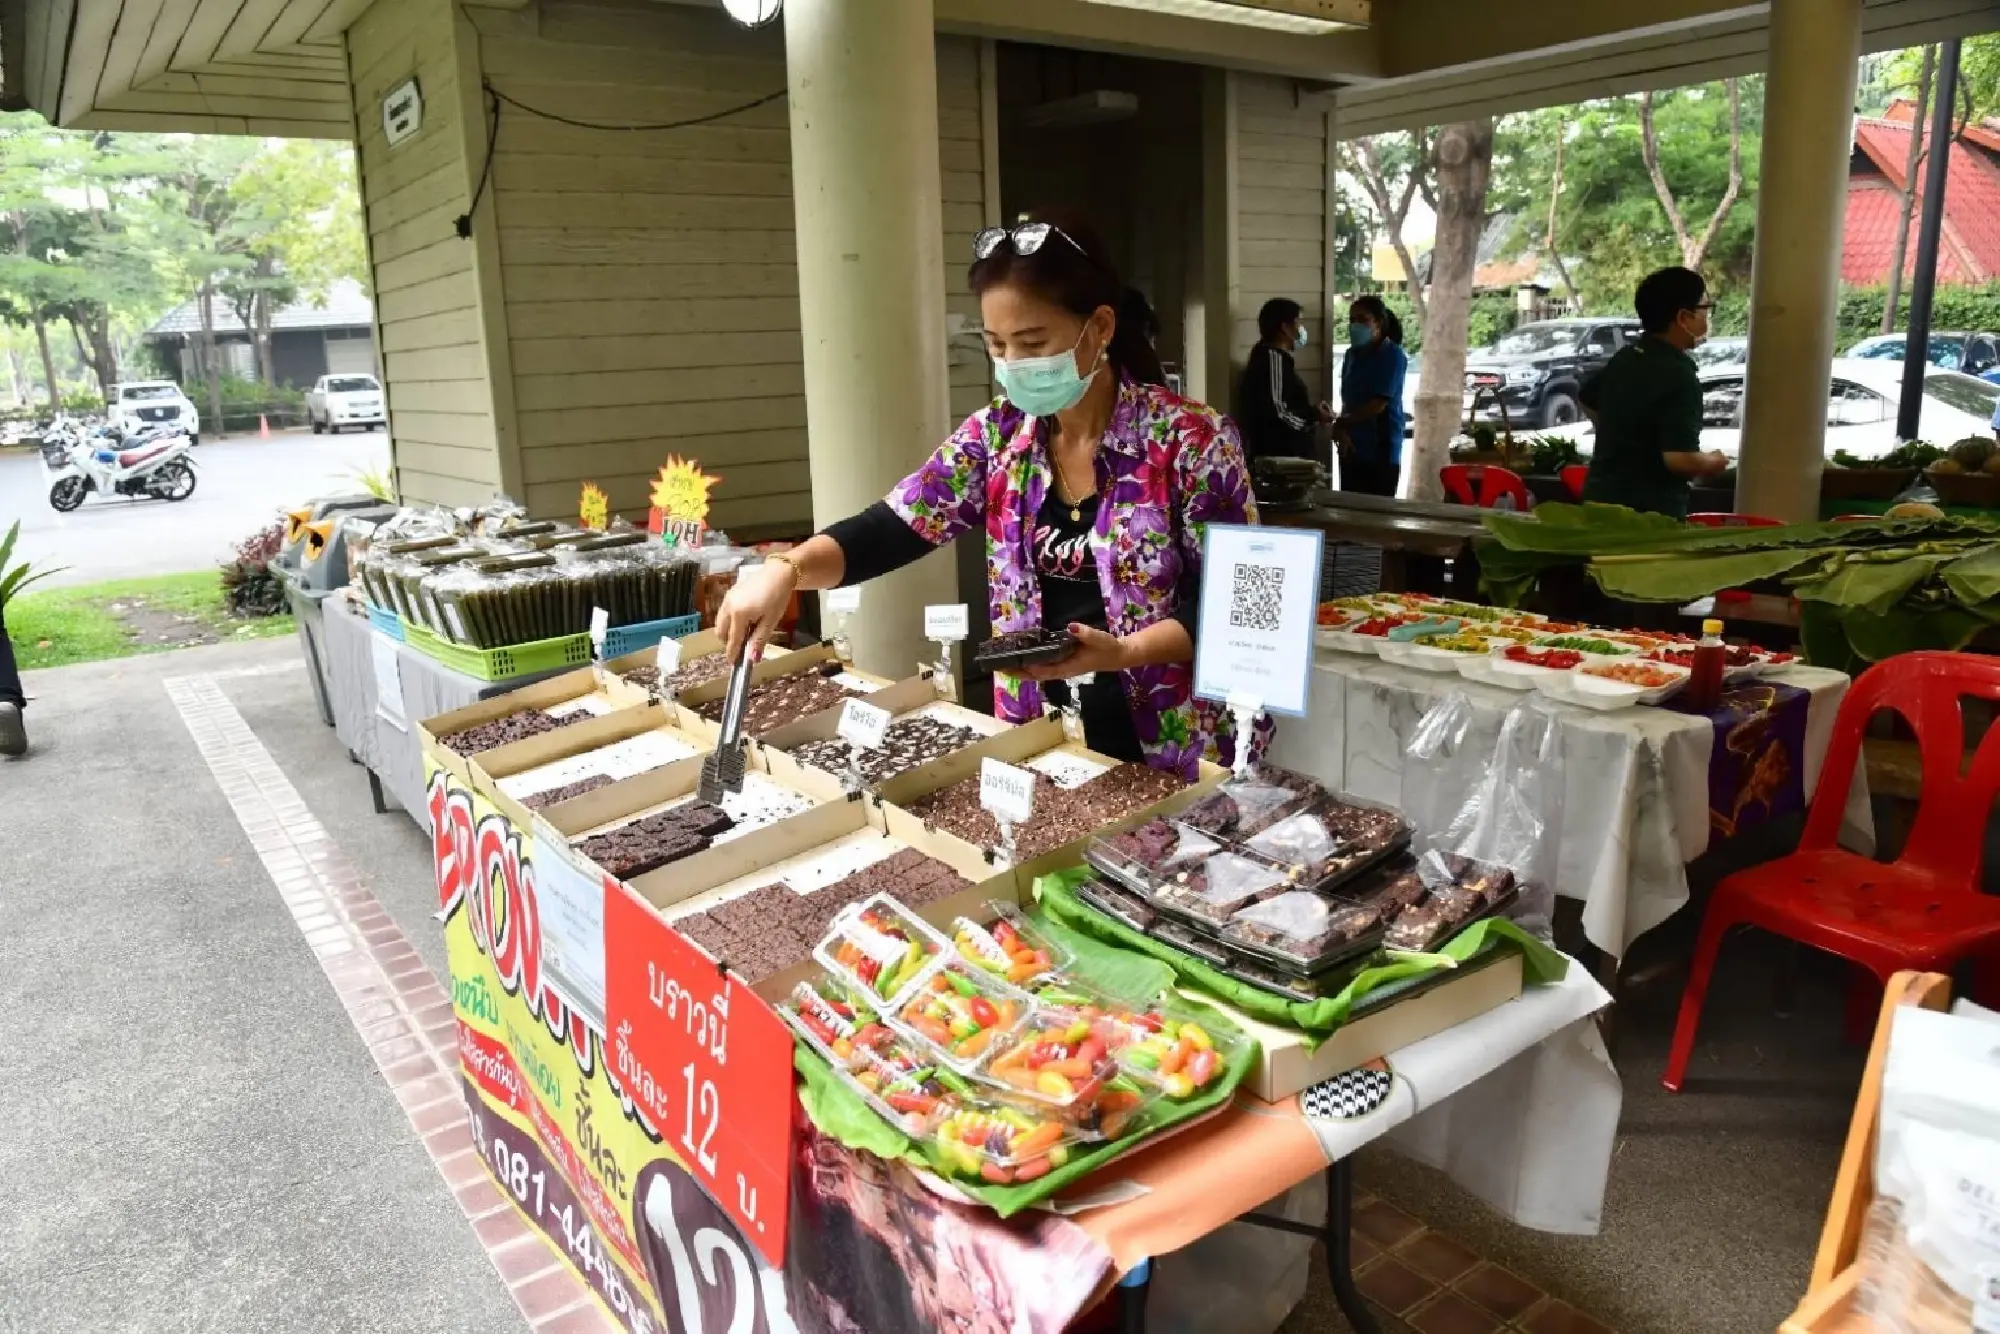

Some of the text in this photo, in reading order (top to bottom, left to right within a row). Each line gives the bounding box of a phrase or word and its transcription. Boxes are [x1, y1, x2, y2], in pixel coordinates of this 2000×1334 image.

[648, 958, 732, 1066] บราวนี่
[615, 1018, 765, 1233] ชิ้นละ 12 บ.
